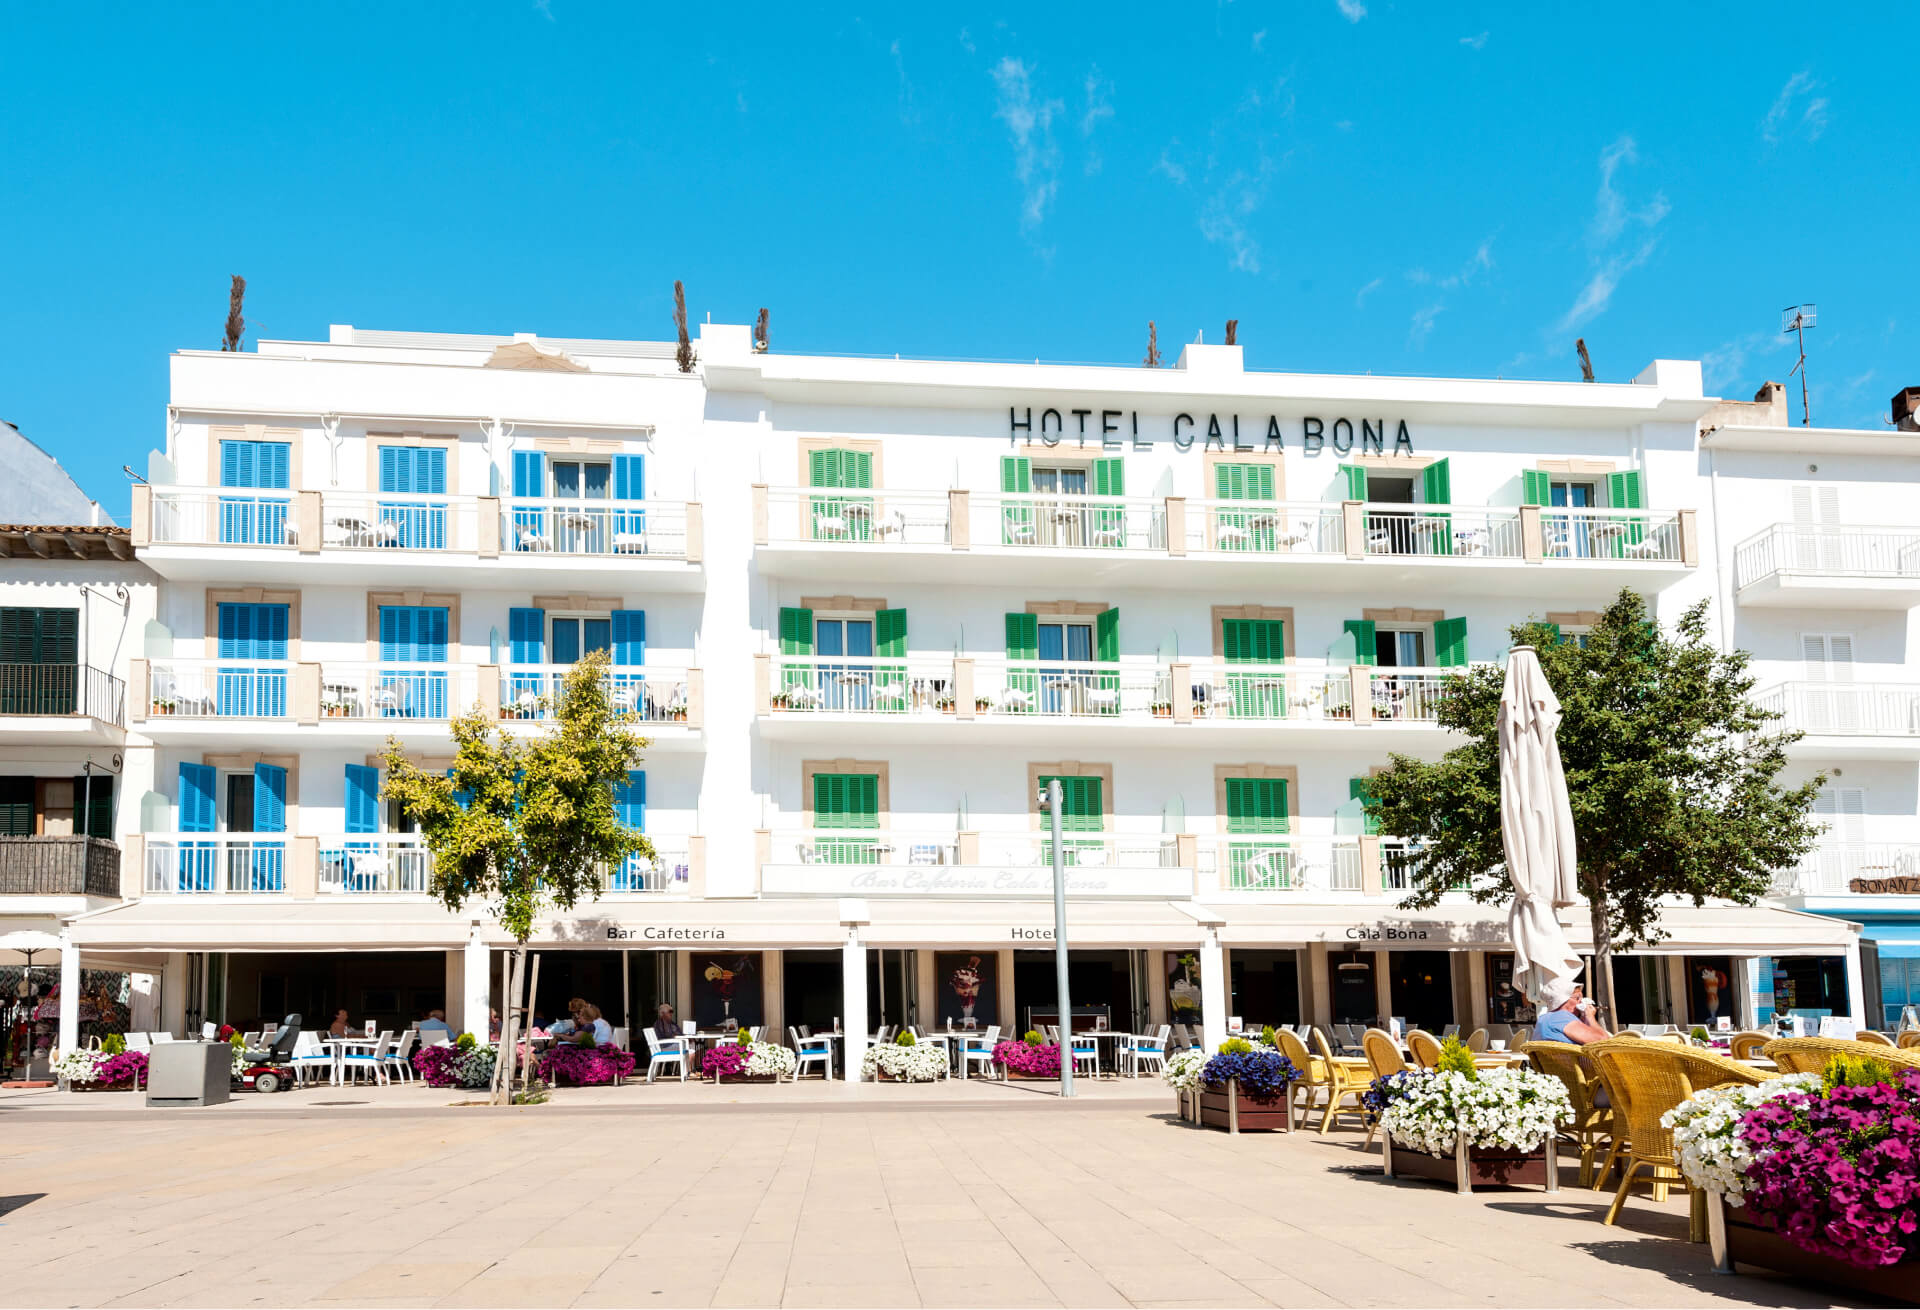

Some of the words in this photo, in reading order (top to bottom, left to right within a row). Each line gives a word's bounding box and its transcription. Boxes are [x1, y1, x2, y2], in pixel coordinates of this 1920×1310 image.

[1009, 406, 1154, 448] HOTEL
[1173, 411, 1284, 454] CALA
[1303, 416, 1415, 457] BONA
[850, 871, 897, 889] Bar
[993, 870, 1039, 889] Cala
[607, 927, 637, 940] Bar
[644, 927, 725, 940] Cafetería
[1011, 927, 1057, 940] Hotel
[1346, 927, 1381, 940] Cala
[1386, 927, 1427, 940] Bona
